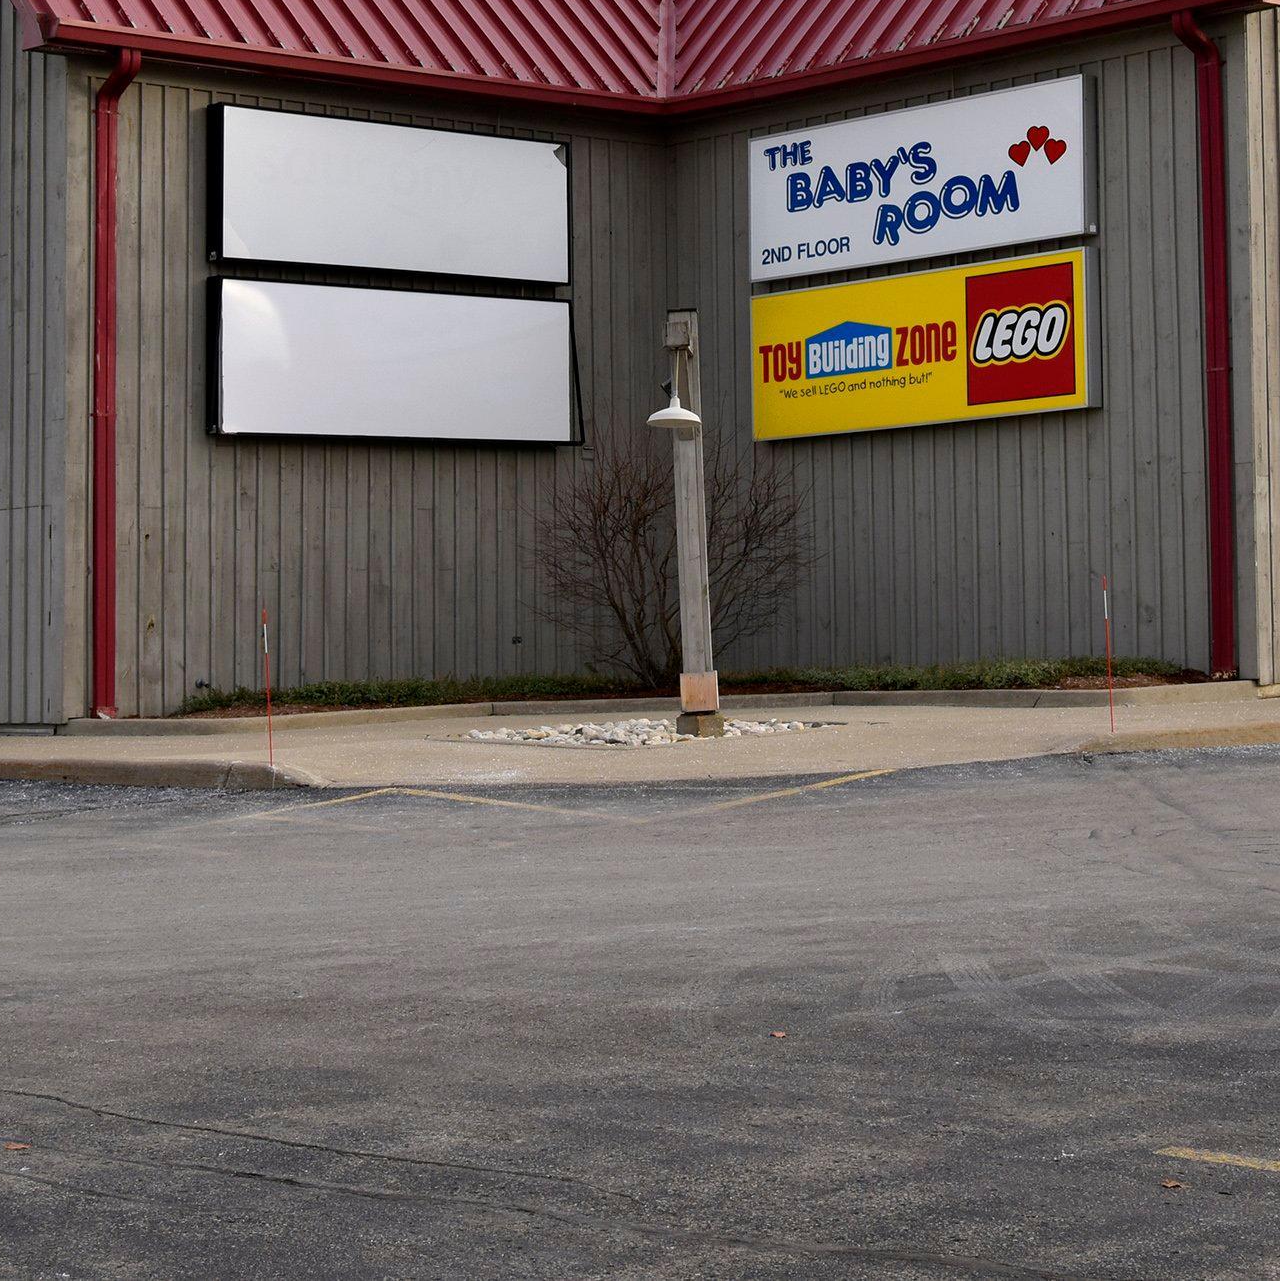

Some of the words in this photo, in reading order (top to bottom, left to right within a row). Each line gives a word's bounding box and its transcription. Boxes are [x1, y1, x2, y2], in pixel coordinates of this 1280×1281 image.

[763, 140, 813, 171] THE
[786, 141, 938, 212] BABY'S
[872, 170, 1020, 246] ROOM
[762, 244, 792, 265] 2ND
[797, 236, 850, 260] FLOOR
[973, 306, 1066, 361] LEGO
[800, 385, 817, 398] sell
[819, 381, 846, 396] LEGO
[848, 379, 867, 392] and
[870, 375, 906, 388] nothing
